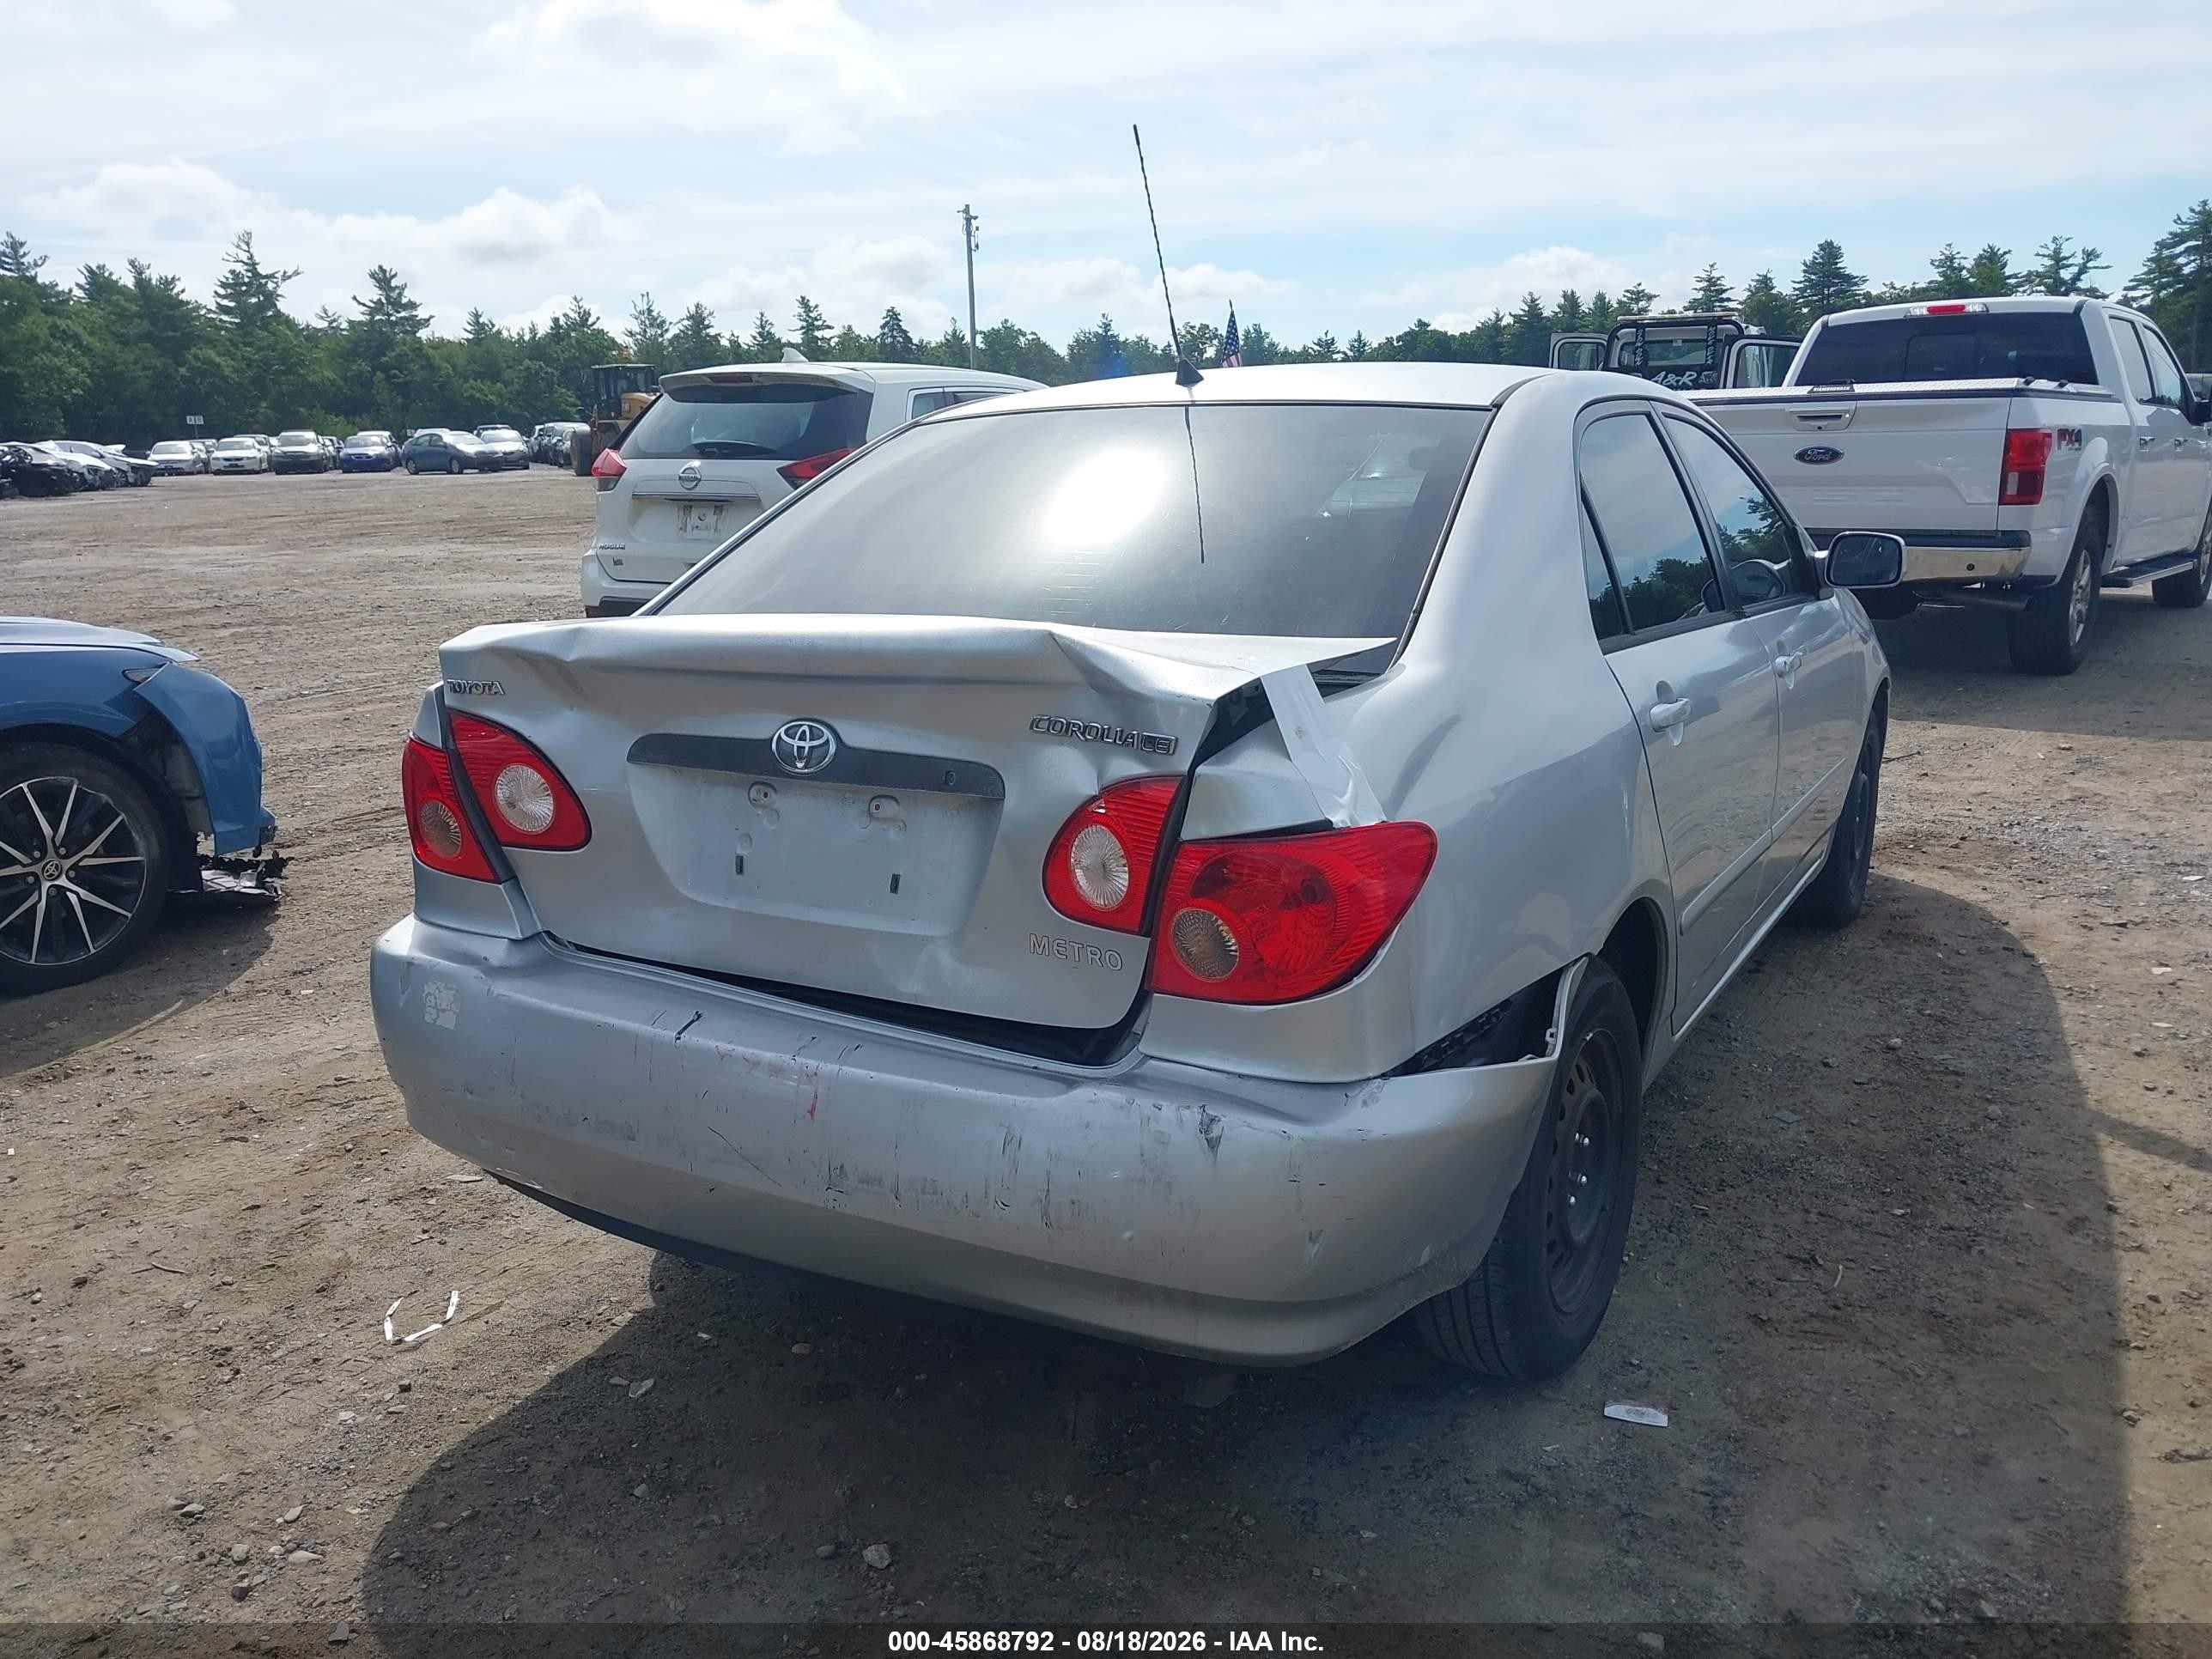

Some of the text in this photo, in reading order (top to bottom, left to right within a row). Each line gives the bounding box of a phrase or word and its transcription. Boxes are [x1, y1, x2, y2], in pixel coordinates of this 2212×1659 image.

[1651, 371, 1698, 386] A&R
[447, 678, 506, 696] TOYOTA
[1030, 714, 1139, 750] COROLLA
[1030, 933, 1124, 971] METRO
